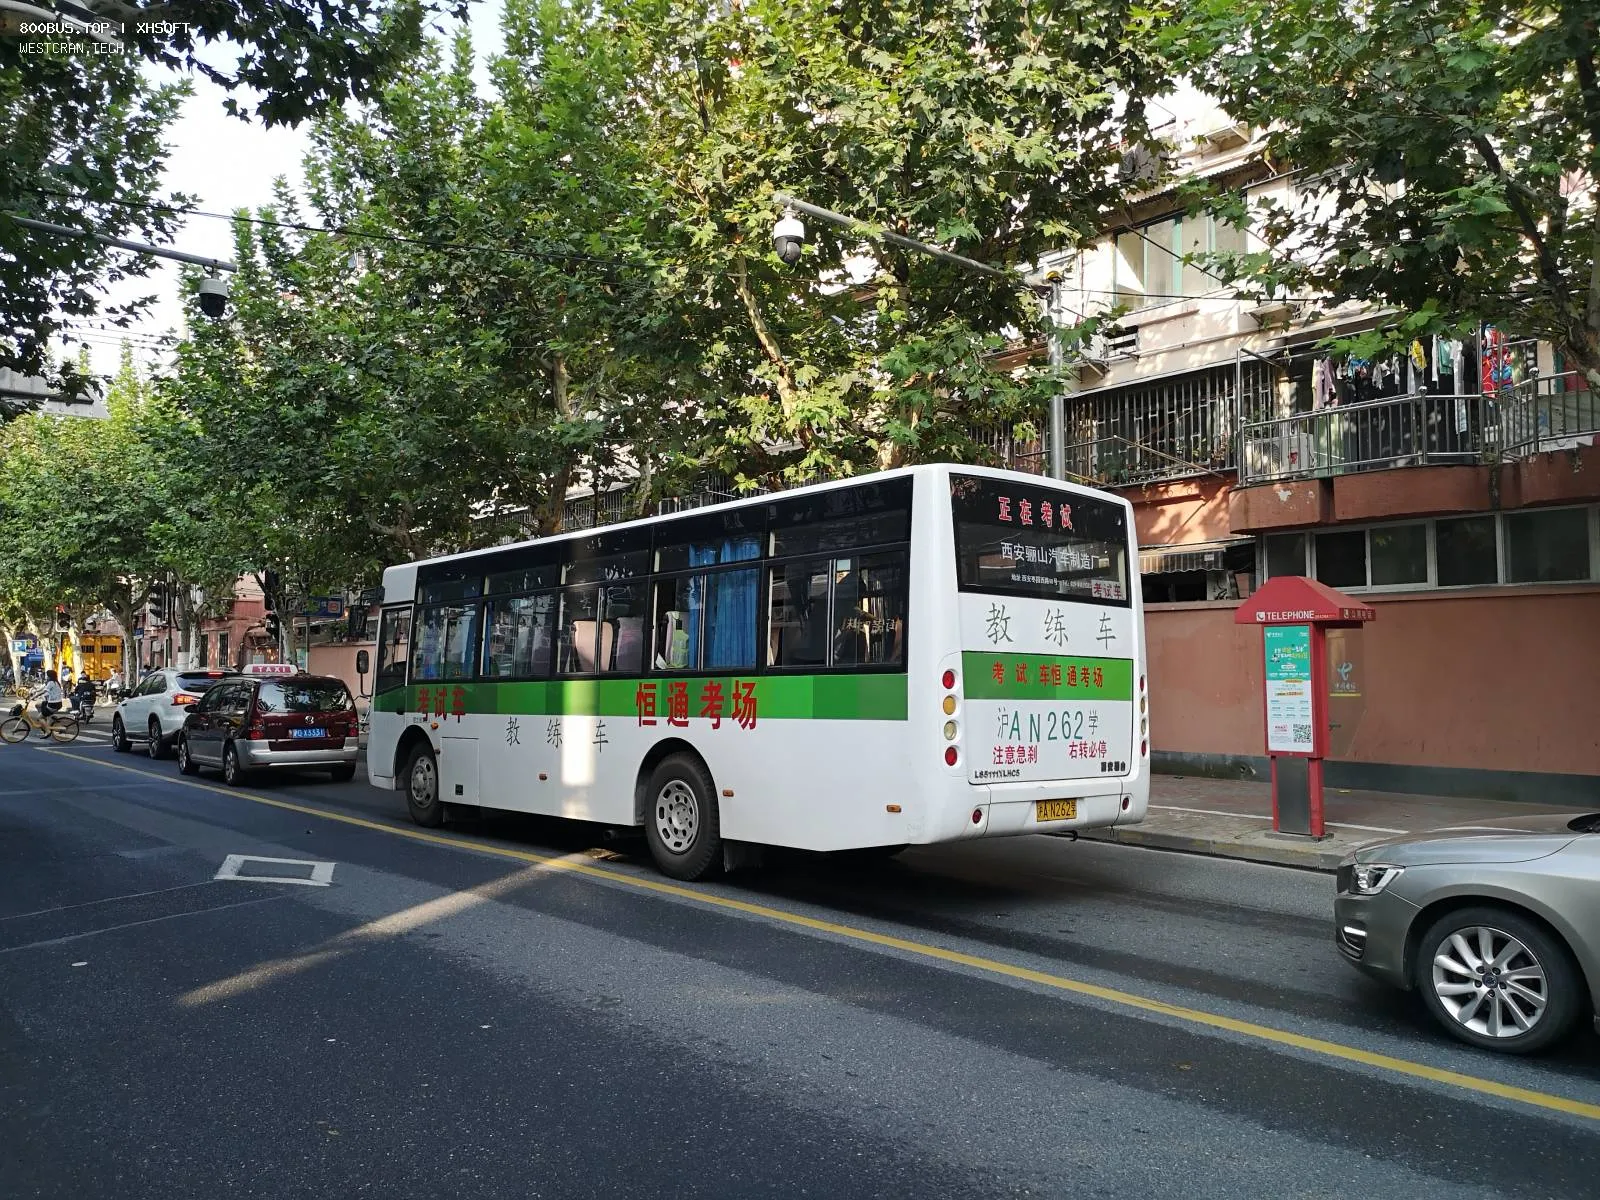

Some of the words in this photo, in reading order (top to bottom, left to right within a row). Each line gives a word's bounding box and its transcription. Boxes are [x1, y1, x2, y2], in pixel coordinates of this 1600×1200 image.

[998, 496, 1073, 530] 正在考试
[1000, 541, 1100, 570] 西安骊山汽车制造厂
[1093, 583, 1122, 598] 考试车
[986, 602, 1117, 651] 教练车
[1266, 610, 1315, 620] TELEPHONE
[13, 641, 22, 651] P
[257, 665, 286, 673] TAXI
[416, 686, 466, 724] 考试车
[636, 679, 758, 730] 恒通考场
[505, 716, 609, 752] 教练车
[992, 745, 1038, 765] 注意急刹
[1068, 740, 1107, 760] 右转必停
